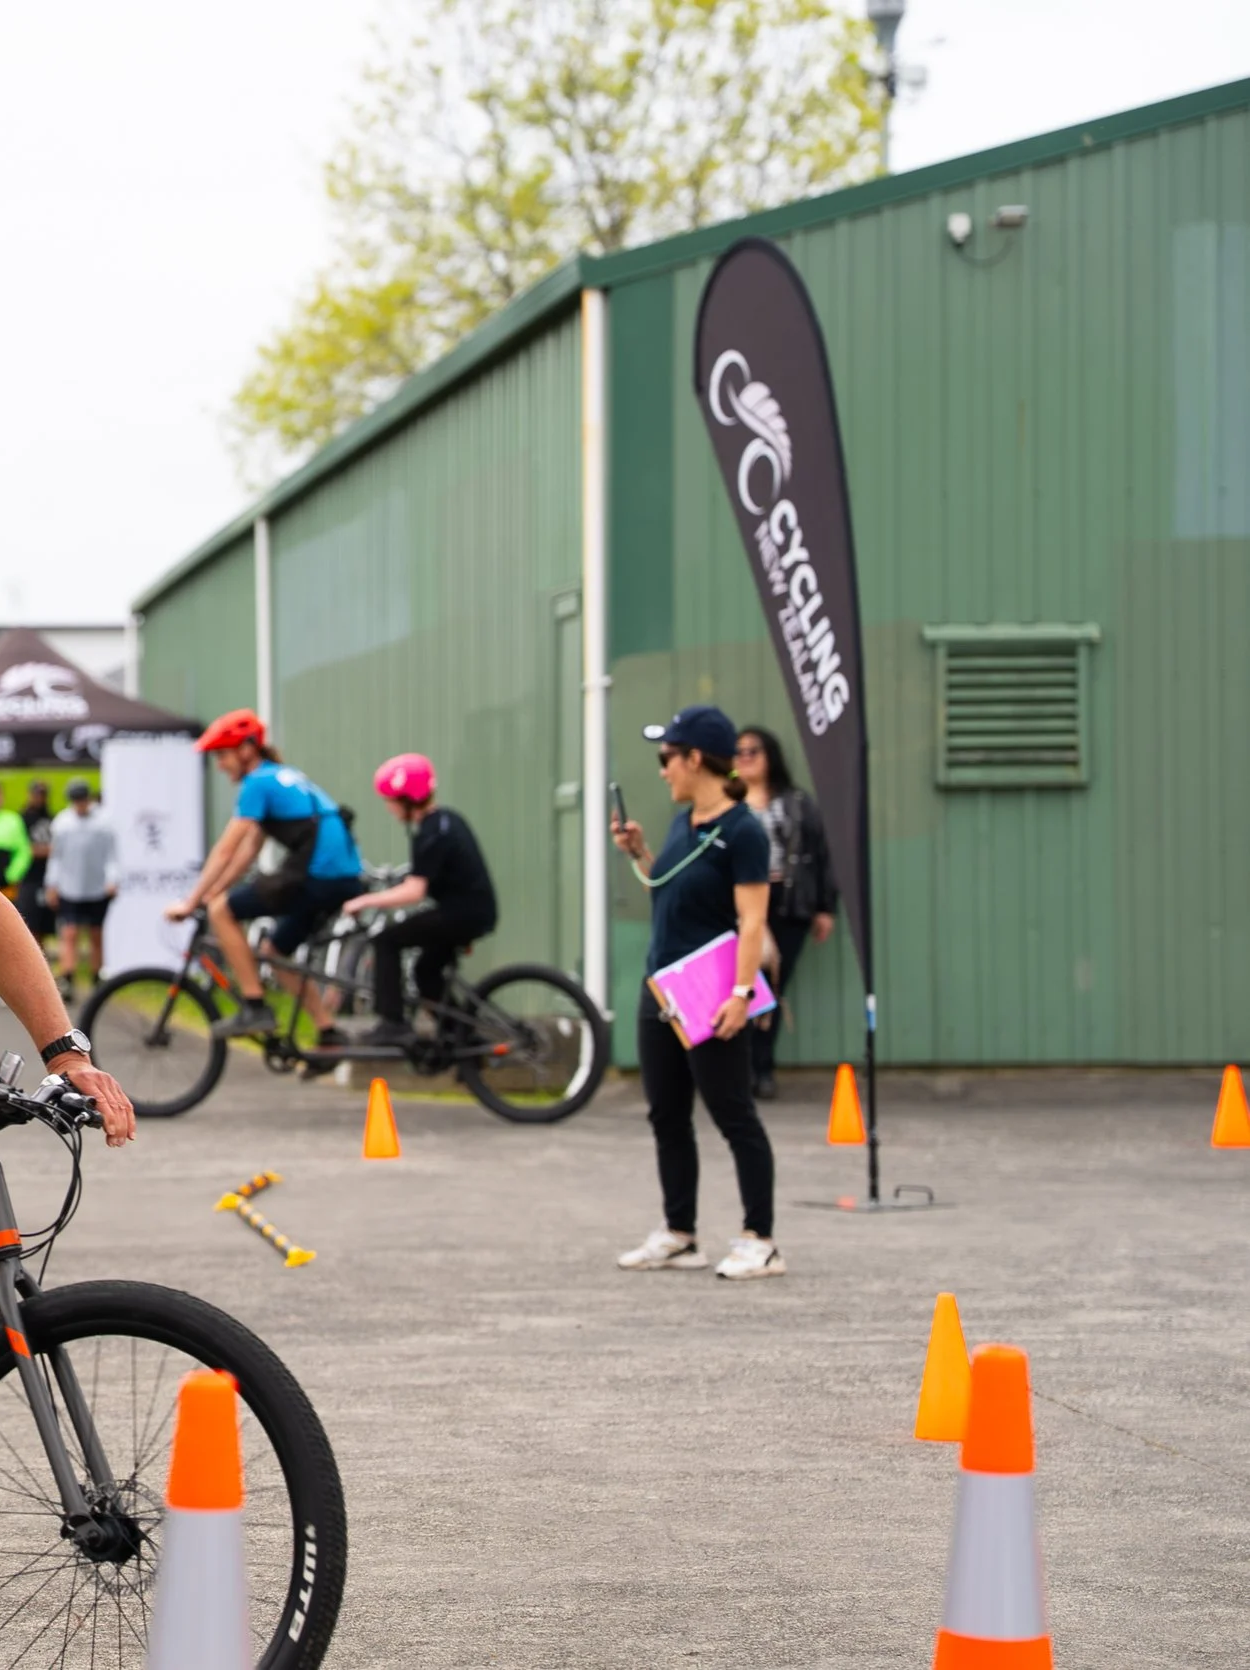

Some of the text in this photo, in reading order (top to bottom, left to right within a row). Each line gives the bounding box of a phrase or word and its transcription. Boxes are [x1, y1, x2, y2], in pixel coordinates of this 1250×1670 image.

[754, 518, 828, 736] NEW ZEALAND
[769, 498, 849, 723] CYCLING
